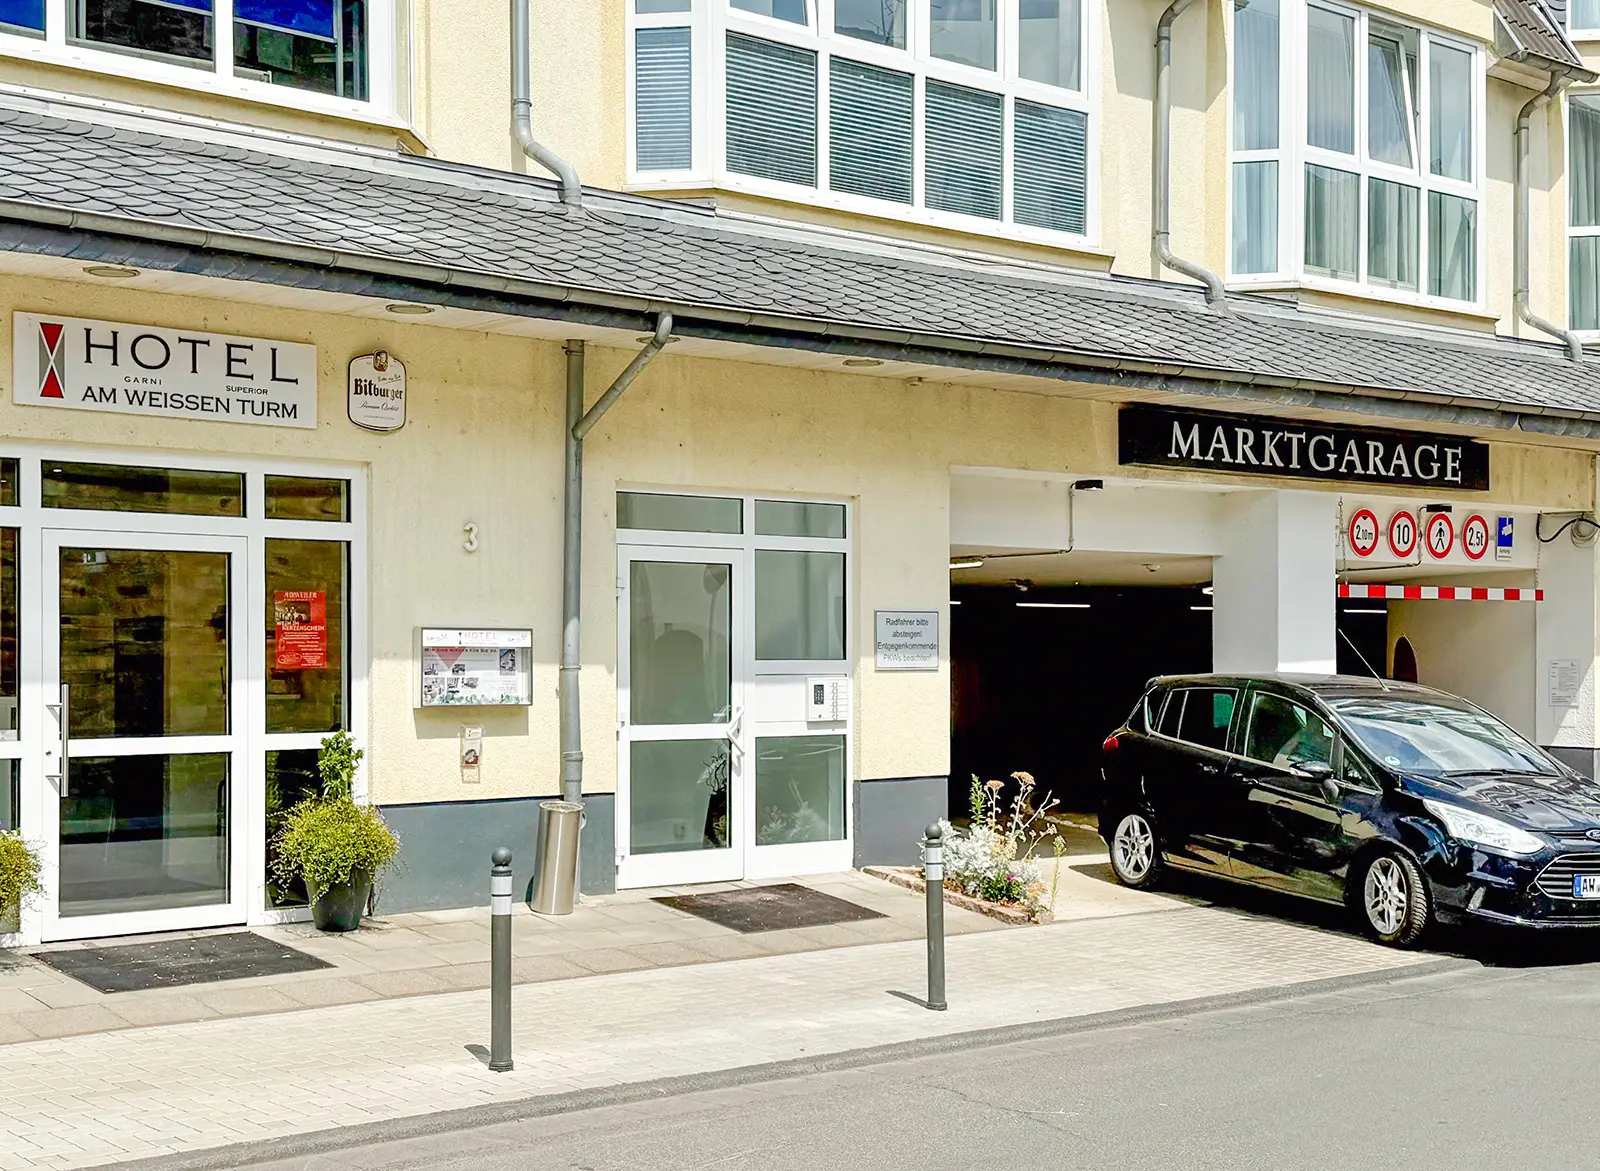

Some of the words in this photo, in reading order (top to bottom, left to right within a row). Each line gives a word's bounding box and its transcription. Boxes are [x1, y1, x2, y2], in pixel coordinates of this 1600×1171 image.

[83, 327, 300, 385] HOTEL
[124, 375, 163, 386] GARNI
[225, 385, 269, 396] SUPERIOR
[353, 378, 403, 400] Bitburger
[81, 385, 117, 404] AM
[124, 390, 231, 414] WEISSEN
[236, 399, 299, 419] TURM
[1167, 421, 1462, 483] MARKTGARAGE
[463, 522, 479, 552] 3
[1396, 524, 1410, 545] 10
[1468, 527, 1484, 547] 2,5t
[885, 617, 915, 626] Radfahrer
[916, 618, 929, 626] bitte
[464, 632, 499, 640] HOTEL
[892, 630, 923, 639] absteigen!
[877, 641, 937, 651] Entgegenkommende
